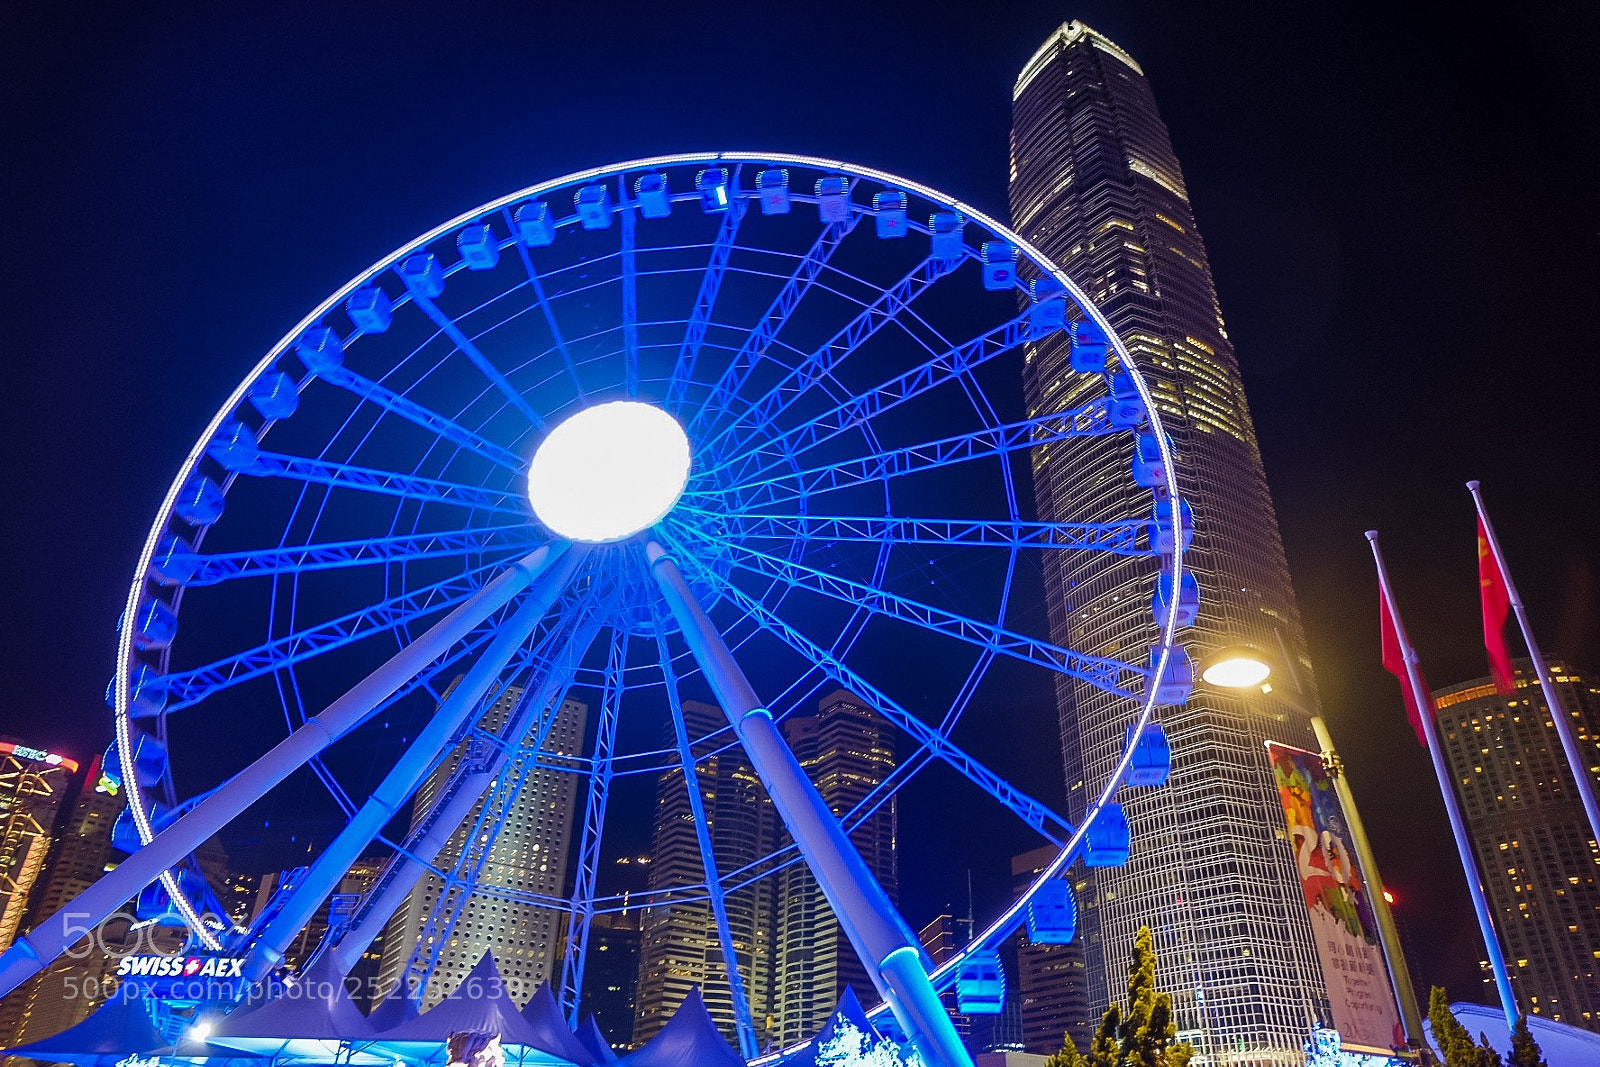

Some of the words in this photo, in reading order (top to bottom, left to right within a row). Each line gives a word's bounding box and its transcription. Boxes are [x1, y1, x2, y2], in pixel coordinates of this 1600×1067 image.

[1292, 825, 1352, 883] 20
[117, 956, 186, 976] SWISS
[199, 958, 246, 977] AEX
